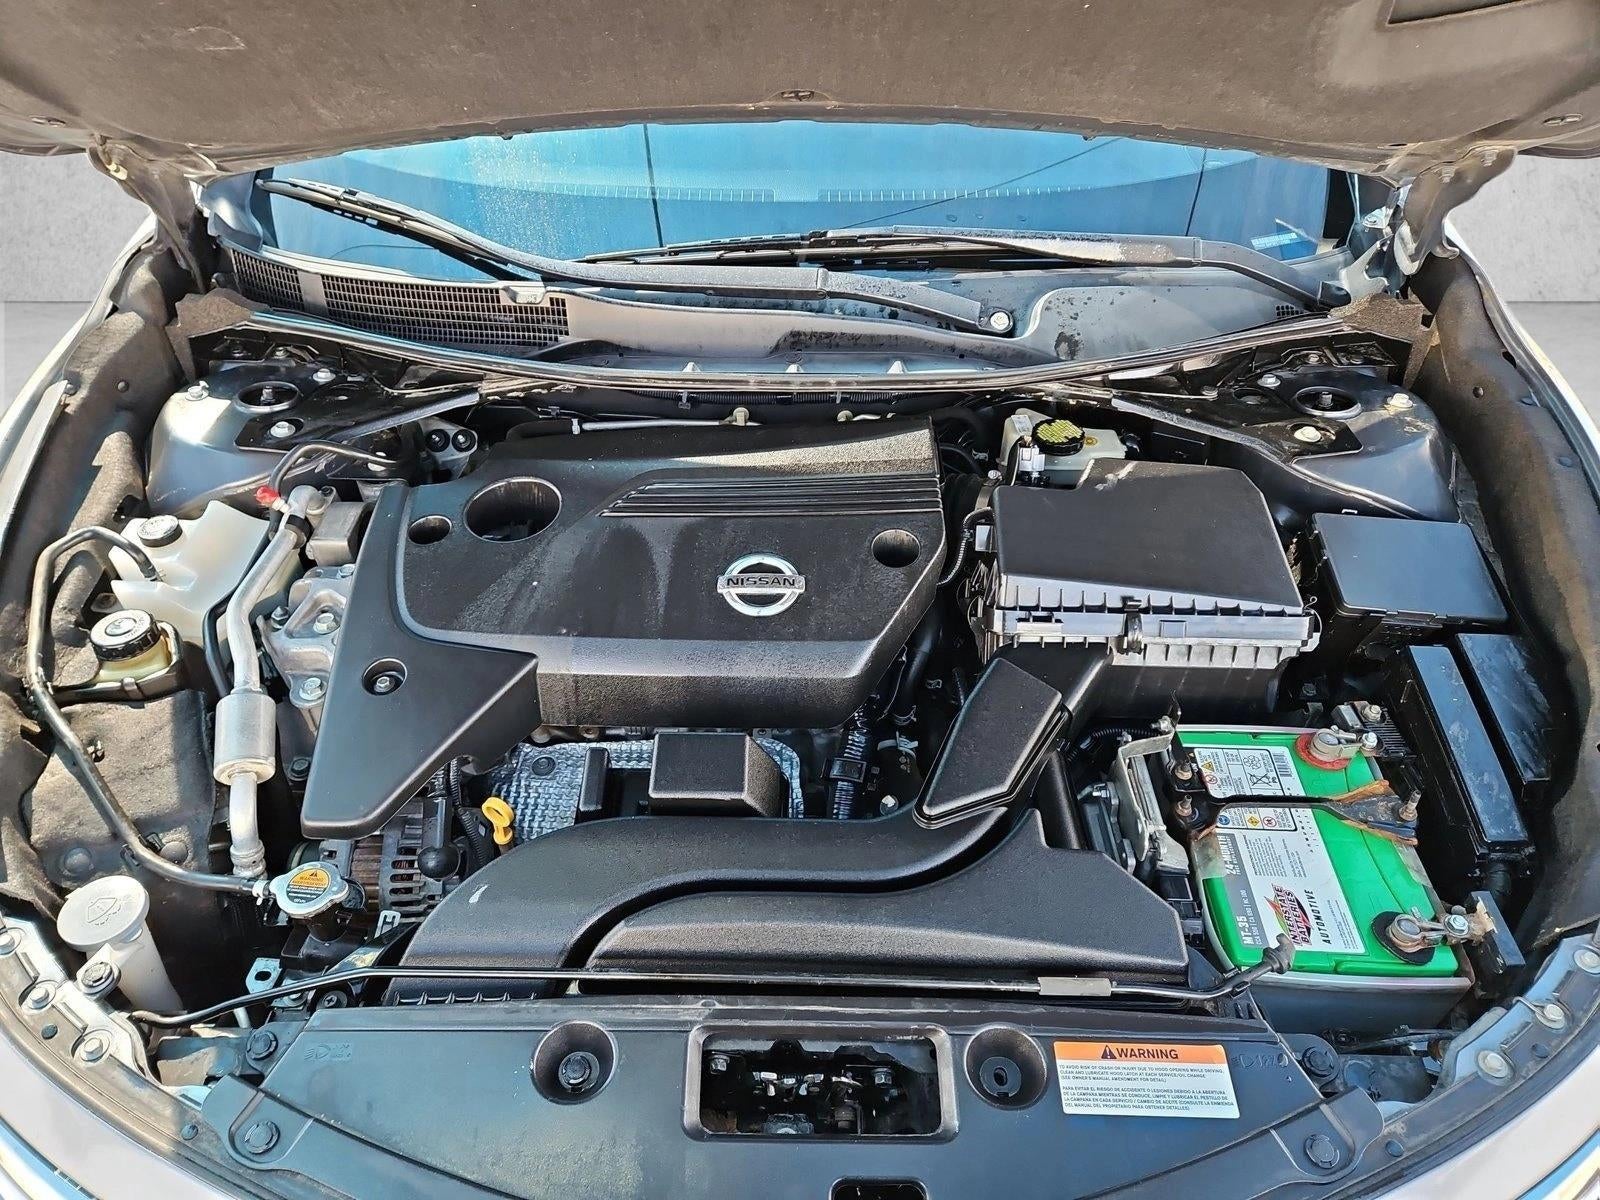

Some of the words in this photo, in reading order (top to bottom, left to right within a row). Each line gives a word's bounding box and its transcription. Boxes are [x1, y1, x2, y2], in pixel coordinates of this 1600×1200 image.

[726, 577, 795, 586] NISSAN
[1216, 834, 1236, 875] 24-MONTH
[1237, 914, 1254, 944] MT-35
[1274, 886, 1302, 945] INTERSTATE
[1285, 890, 1310, 944] BATTERIES
[1304, 889, 1332, 944] AUTOMOTIVE
[1116, 1048, 1179, 1059] WARNING
